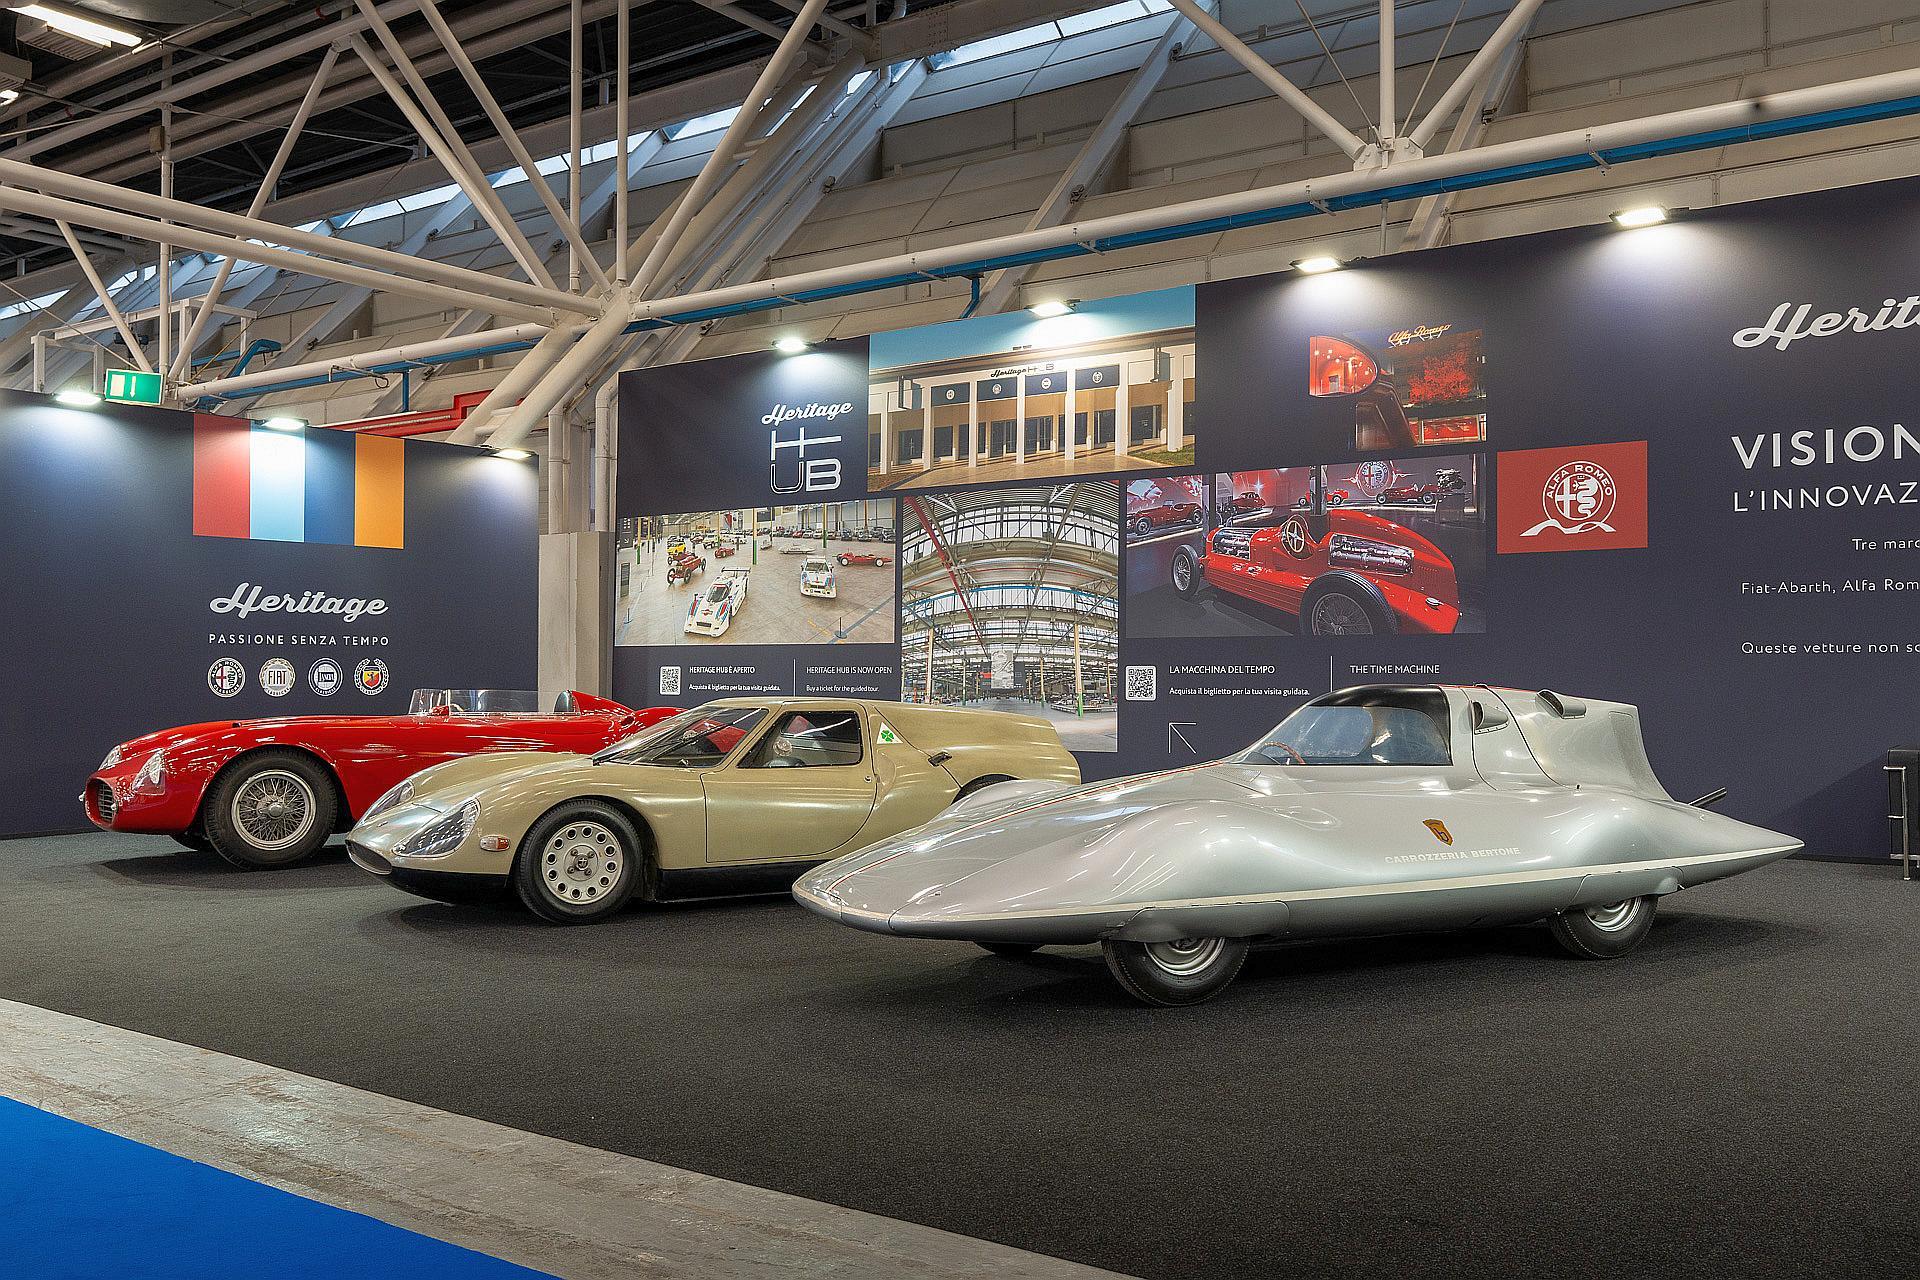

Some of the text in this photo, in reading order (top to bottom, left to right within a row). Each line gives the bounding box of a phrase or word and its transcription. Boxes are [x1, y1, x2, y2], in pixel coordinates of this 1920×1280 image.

[1732, 296, 1920, 351] Herit
[761, 402, 854, 427] Heritage
[770, 426, 842, 494] HUB
[1546, 464, 1613, 499] ALFA ROMEO
[1851, 538, 1877, 550] Tre
[1741, 578, 1919, 594] Fiat-Abarth, Alfa Rom
[209, 582, 389, 623] Heritage
[209, 633, 389, 646] PASSIONE SENZA TEMPO
[1741, 642, 1797, 654] Queste
[1803, 643, 1862, 654] vetture
[1868, 643, 1899, 653] non
[689, 666, 715, 674] HERITAGE
[716, 666, 729, 674] HUB
[733, 666, 756, 674] APERTO
[806, 666, 893, 674] HERITAGE HUB IS NOW OPEN
[1169, 665, 1276, 674] LA MACCHINA DEL TEMPO
[1349, 664, 1440, 674] THE TIME MACHINE
[268, 670, 287, 685] FIAT
[806, 684, 816, 693] Buy
[820, 684, 833, 692] ticket
[833, 684, 841, 692] for
[841, 684, 850, 692] the
[850, 684, 867, 693] guided
[1169, 687, 1197, 696] Acquista
[1197, 687, 1203, 695] il
[1203, 687, 1231, 696] biglietto
[1232, 689, 1244, 697] per
[1244, 687, 1251, 695] la
[1263, 687, 1282, 695] visita
[1282, 687, 1310, 697] guidata.
[1384, 847, 1521, 865] CARROZZERIA BERTONE
